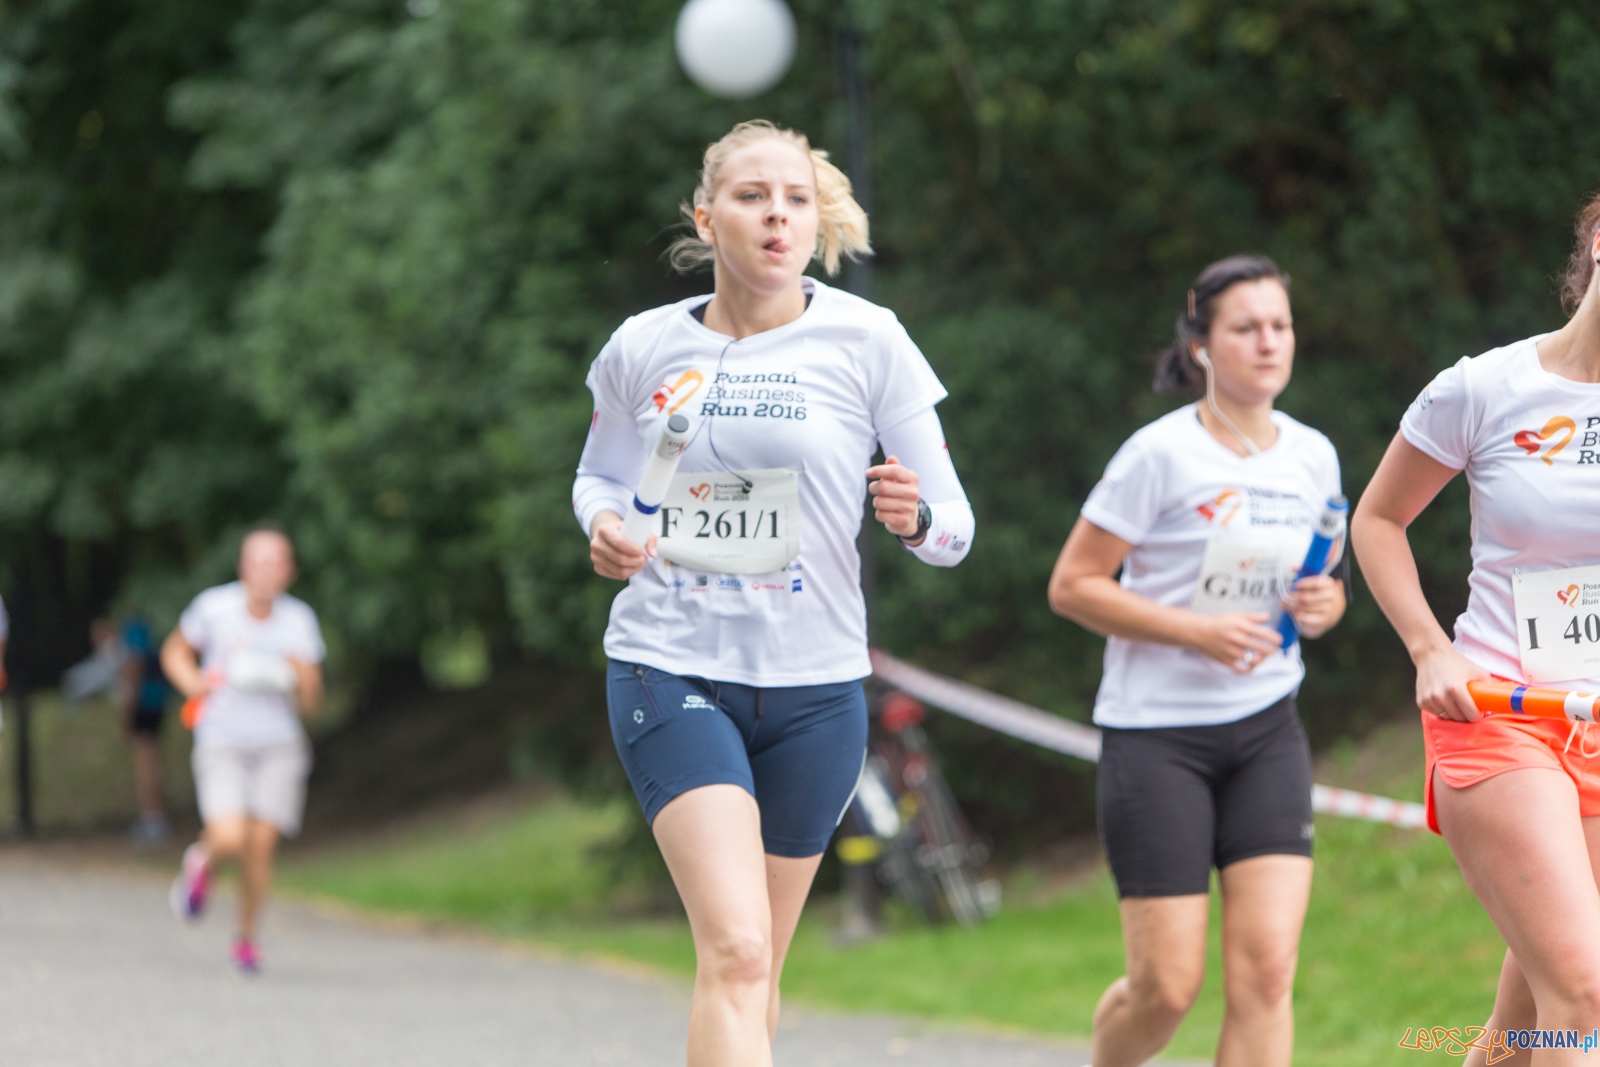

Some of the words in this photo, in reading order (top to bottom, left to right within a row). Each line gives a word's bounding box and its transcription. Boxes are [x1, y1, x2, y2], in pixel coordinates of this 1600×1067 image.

[713, 371, 798, 385] Poznań
[705, 385, 806, 404] Business
[699, 402, 748, 417] Run
[753, 403, 807, 421] 2016
[660, 507, 683, 538] F
[694, 508, 781, 539] 261/1
[1582, 598, 1599, 606] Run
[1523, 616, 1543, 651] I
